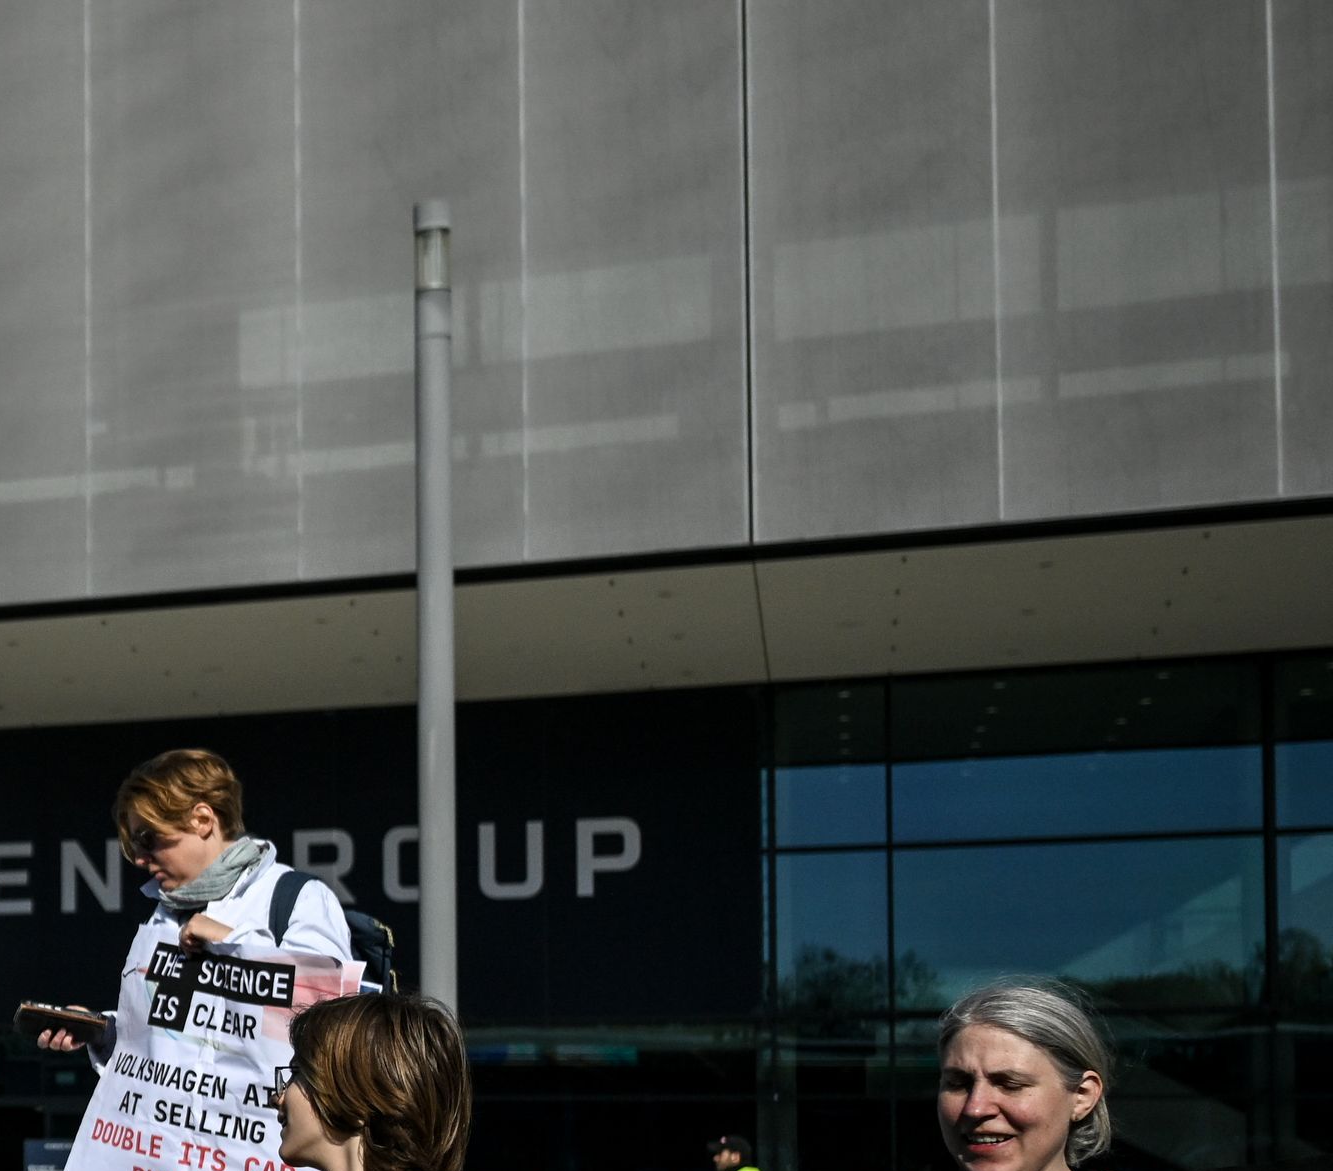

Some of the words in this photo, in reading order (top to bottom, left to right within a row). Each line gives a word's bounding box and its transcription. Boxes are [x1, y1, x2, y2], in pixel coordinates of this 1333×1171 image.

[151, 950, 184, 979] THE
[197, 960, 290, 1000] SCIENCE
[152, 993, 180, 1022] IS
[192, 1003, 257, 1040] CLEAR
[114, 1051, 228, 1100] VOLKSWAGEN
[91, 1118, 164, 1160] DOUBLE
[118, 1090, 143, 1116] AT
[153, 1099, 266, 1145] SELLING
